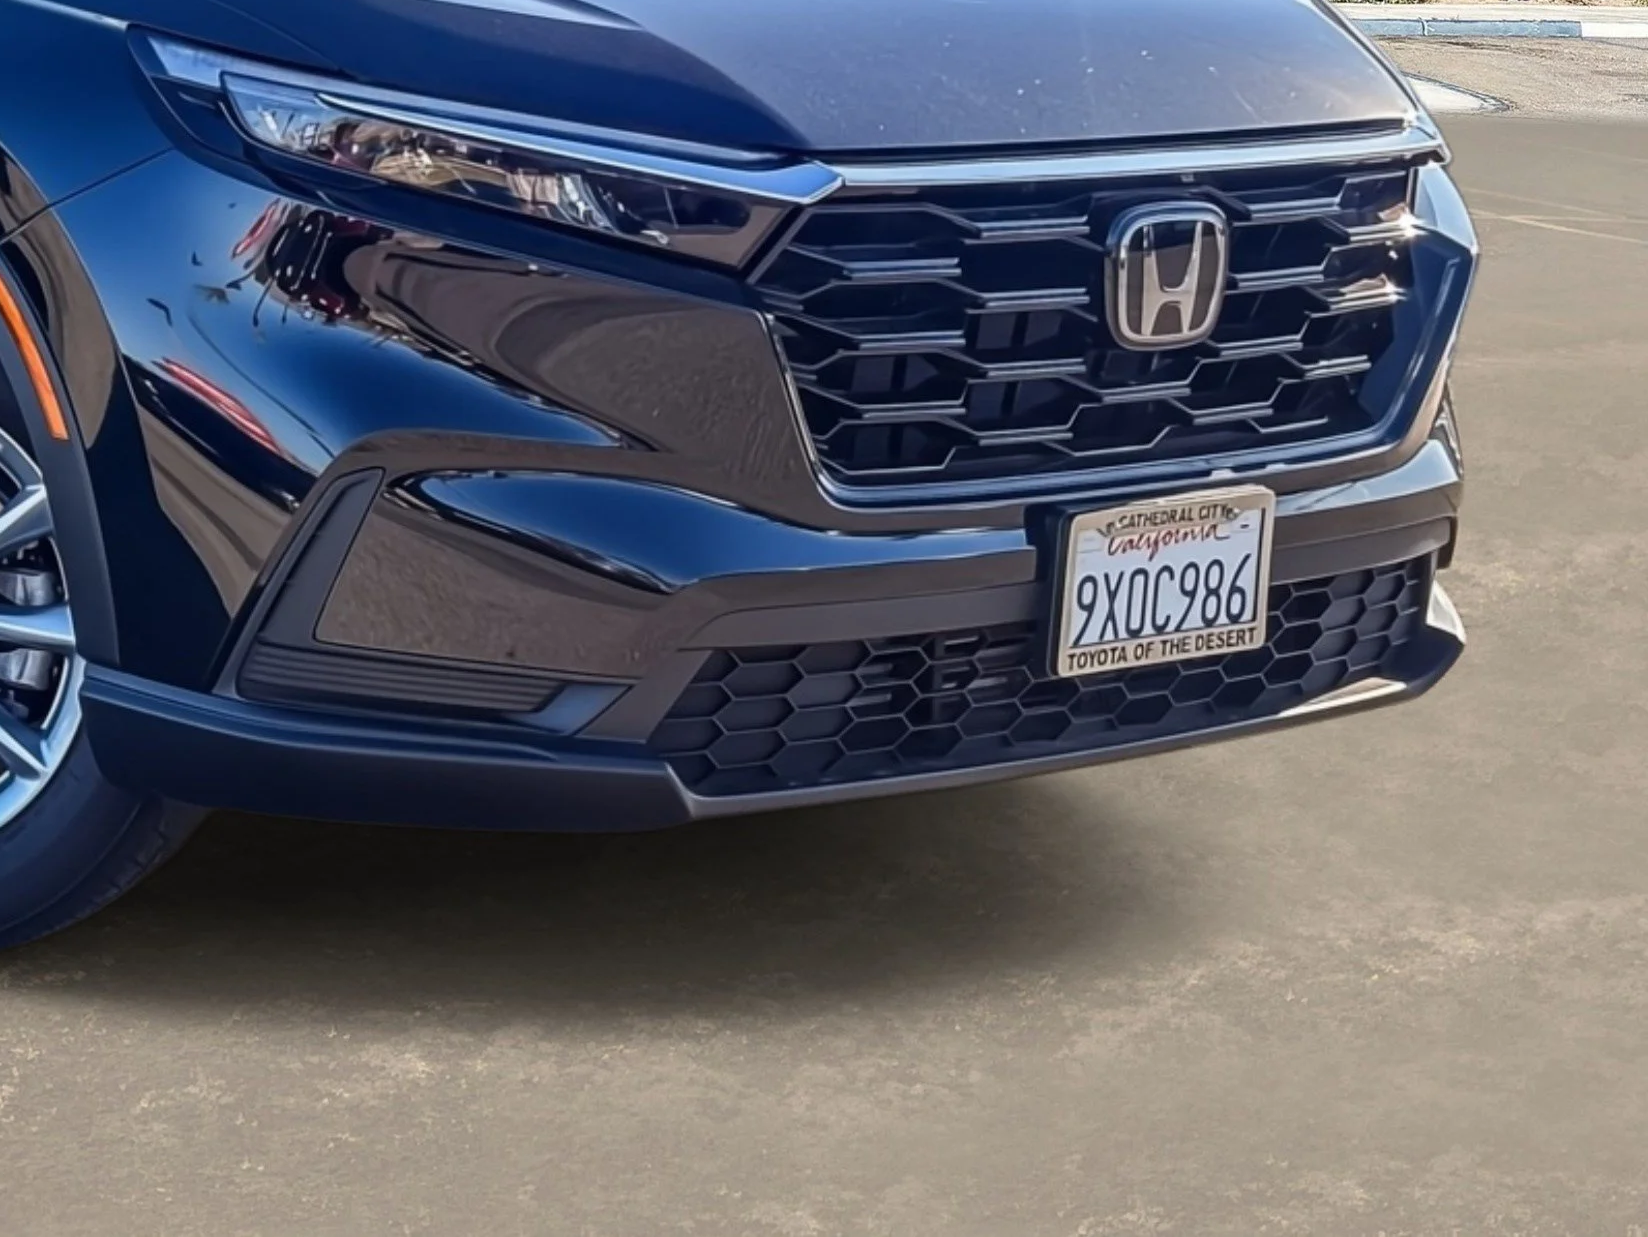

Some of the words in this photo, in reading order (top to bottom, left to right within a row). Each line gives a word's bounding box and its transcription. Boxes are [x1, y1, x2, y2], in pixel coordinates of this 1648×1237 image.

[1118, 506, 1195, 530] CATHEDRAL
[1198, 504, 1228, 521] CITY
[1108, 523, 1230, 561] California
[1067, 646, 1129, 671] TOYOTA
[1134, 640, 1155, 660] OF
[1161, 636, 1192, 656] THE
[1195, 626, 1258, 652] DESERT
